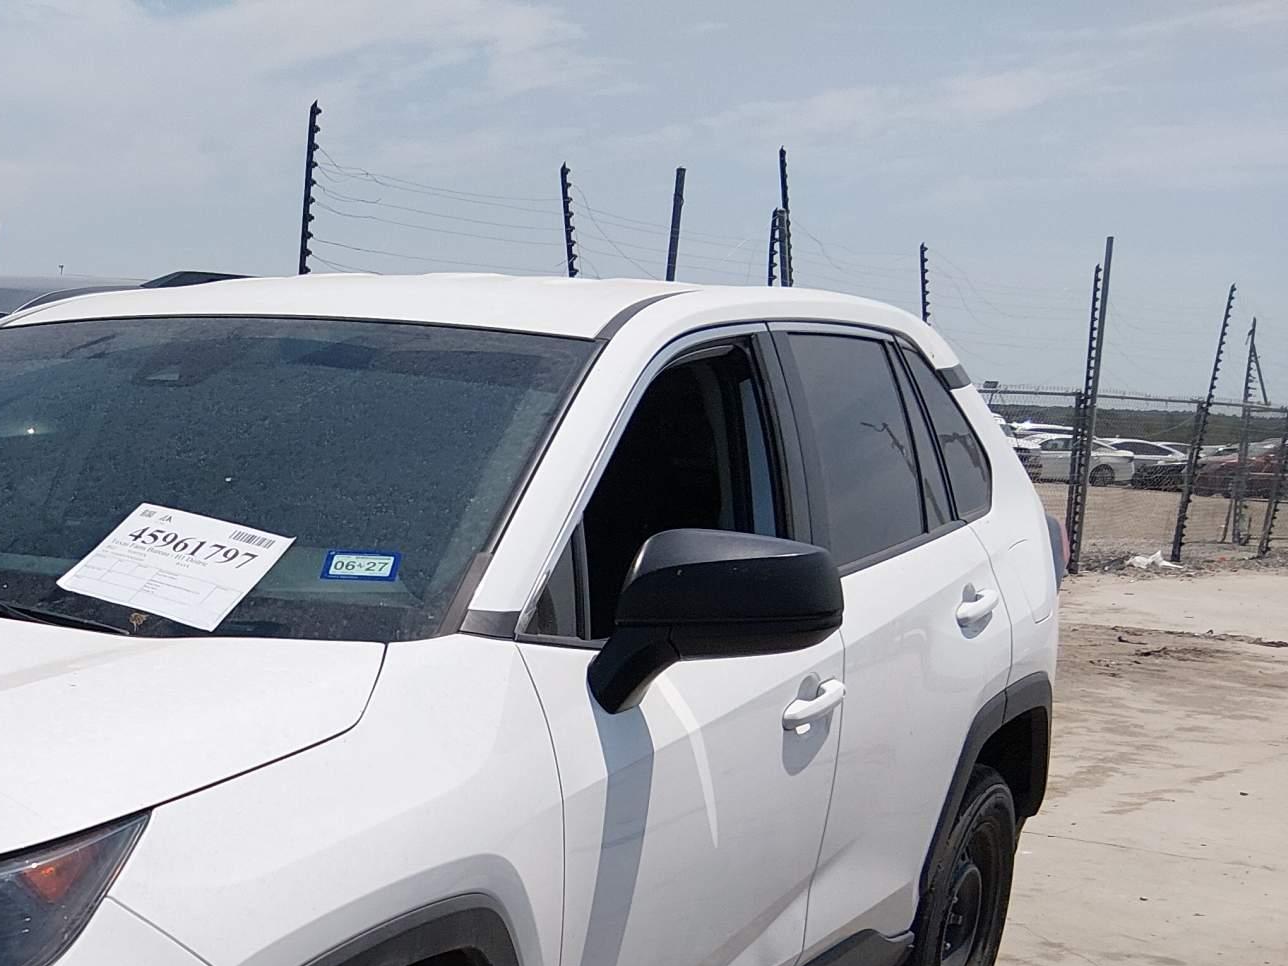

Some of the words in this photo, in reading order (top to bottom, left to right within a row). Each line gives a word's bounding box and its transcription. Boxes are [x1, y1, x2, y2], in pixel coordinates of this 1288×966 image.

[128, 526, 259, 569] 45961797
[334, 560, 357, 571] 06
[365, 561, 389, 572] 27
